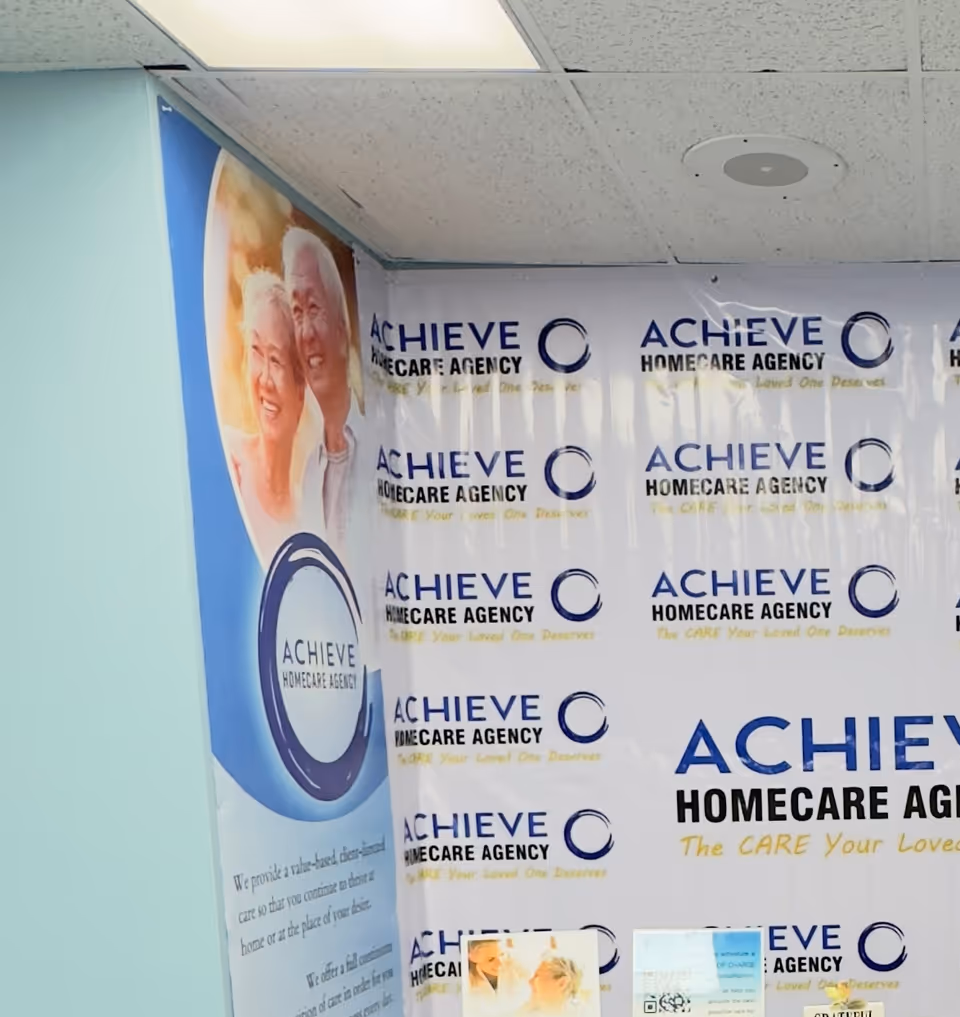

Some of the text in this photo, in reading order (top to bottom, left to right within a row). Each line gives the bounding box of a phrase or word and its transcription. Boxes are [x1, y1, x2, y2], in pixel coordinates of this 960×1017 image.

[370, 312, 520, 352] ACHIEVE
[641, 317, 823, 347] ACHIEVE
[450, 357, 522, 375] AGENCY
[641, 352, 825, 372] HOMECARE AGENCY
[377, 447, 525, 481] ACHIEVE
[645, 442, 826, 472] ACHIEVE
[456, 485, 527, 502] AGENCY
[646, 476, 827, 496] HOMECARE AGENCY
[385, 572, 532, 601] ACHIEVE
[652, 569, 830, 597] ACHIEVE
[464, 606, 534, 623] AGENCY
[652, 602, 831, 621] HOMECARE AGENCY
[282, 639, 356, 668] ACHIEVE
[283, 671, 356, 690] HOMECARE AGENCY
[395, 695, 540, 723] ACHIEVE
[473, 728, 542, 744] AGENCY
[677, 786, 888, 823] HOMECARE
[405, 812, 548, 845] ACHIEVE
[482, 844, 549, 860] AGENCY
[680, 835, 723, 857] The
[738, 834, 809, 856] CARE
[824, 834, 881, 858] Your
[234, 873, 248, 891] We
[251, 863, 281, 894] provide
[284, 866, 288, 878] a
[238, 908, 255, 924] care
[258, 904, 267, 917] so
[269, 896, 284, 913] that
[287, 894, 302, 910] you
[304, 881, 337, 902] continue
[240, 937, 264, 956] home
[267, 932, 276, 946] or
[278, 928, 286, 941] at
[288, 921, 300, 937] the
[302, 913, 321, 938] place
[323, 905, 332, 925] of
[333, 907, 350, 927] your
[306, 952, 358, 989] We offer a full
[774, 956, 842, 972] AGENCY
[319, 994, 326, 1012] of
[328, 994, 342, 1008] care
[344, 986, 352, 1000] in
[353, 977, 370, 996] order
